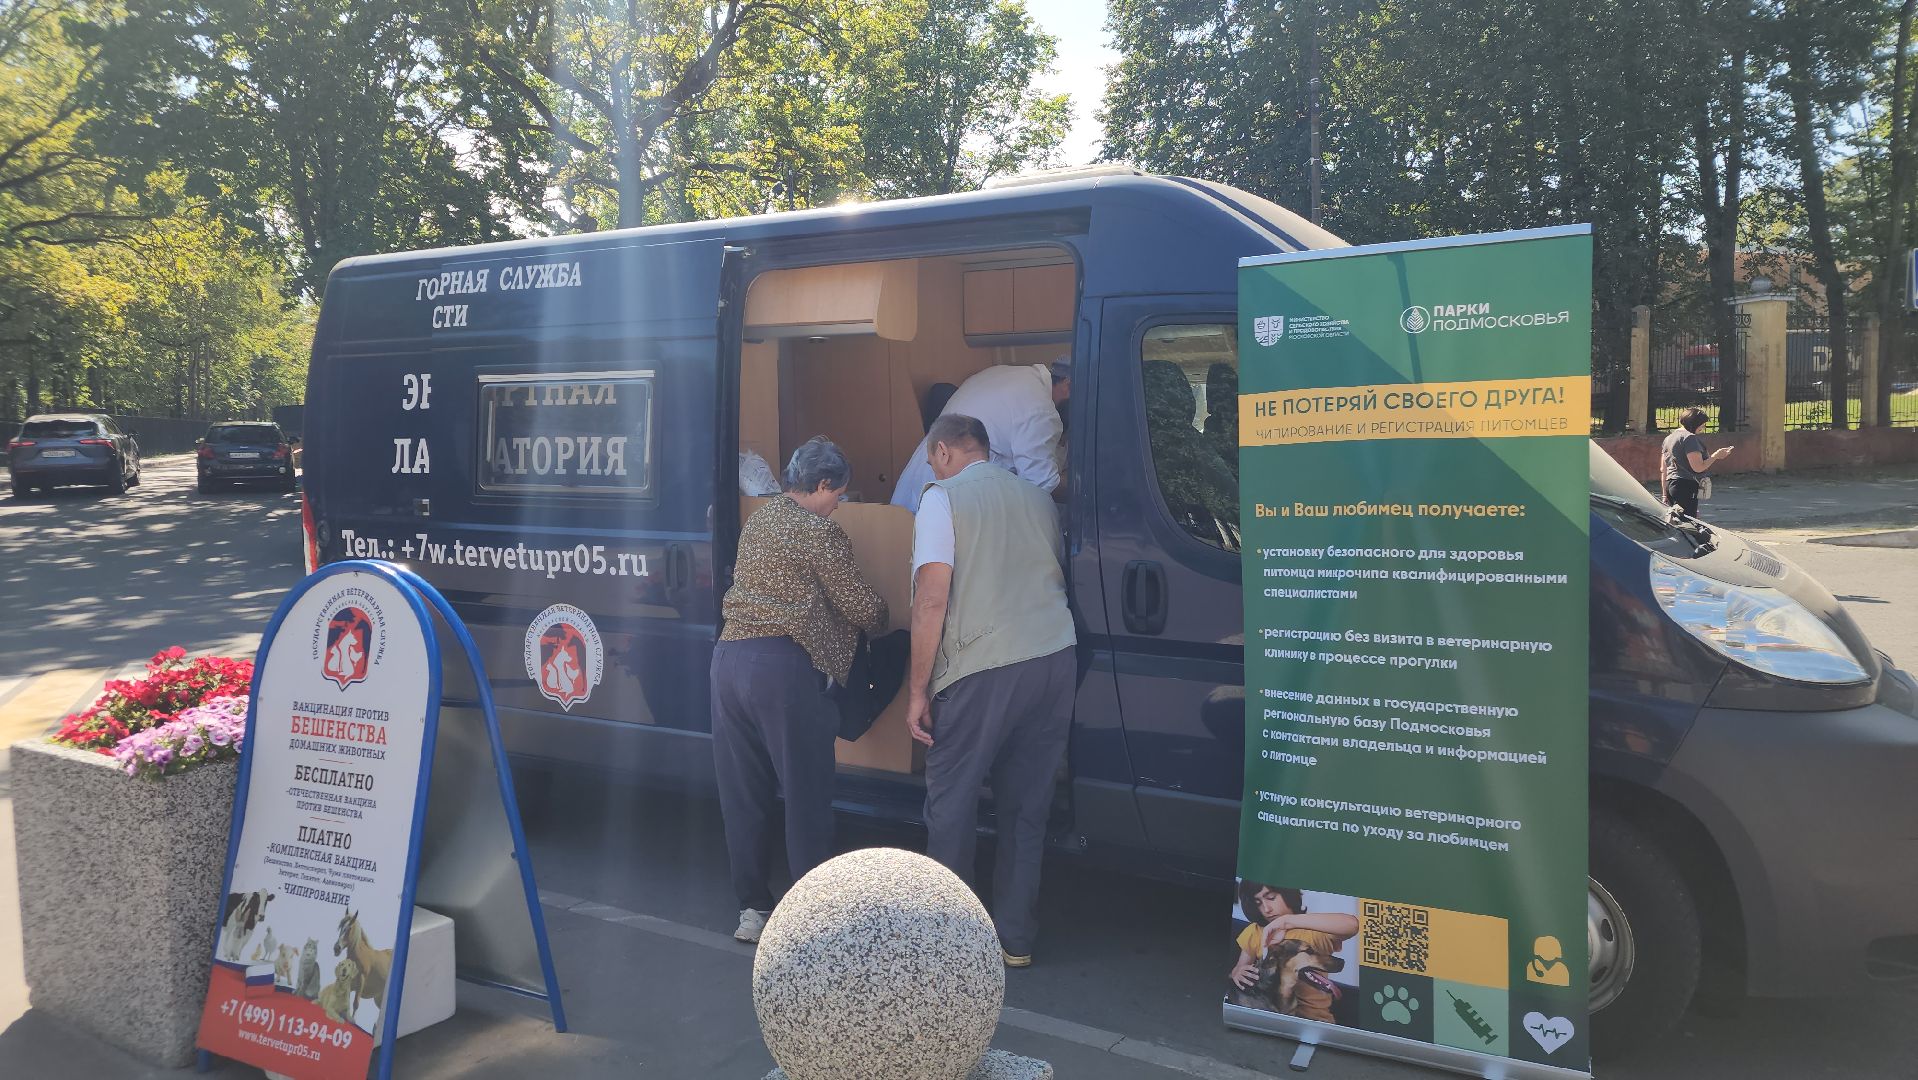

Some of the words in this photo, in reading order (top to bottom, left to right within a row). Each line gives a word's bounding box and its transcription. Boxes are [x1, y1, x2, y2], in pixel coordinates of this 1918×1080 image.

[416, 268, 490, 300] ГОРНАЯ
[500, 262, 582, 291] СЛУЖБА
[432, 304, 469, 329] СТИ
[1433, 302, 1490, 317] ПАРКИ
[1433, 311, 1570, 332] ПОДМОСКОВЬЯ
[1255, 400, 1277, 418] НЕ
[1282, 389, 1377, 416] ПОТЕРЯЙ
[1383, 390, 1478, 410] СВОЕГО
[1484, 386, 1565, 411] ДРУГА!
[1255, 422, 1352, 440] ЧИПИРОВАНИЕ
[1356, 422, 1367, 435] И
[1370, 420, 1476, 436] РЕГИСТРАЦИЯ
[1479, 416, 1568, 433] ПИТОМЦЕВ
[391, 438, 430, 474] ЛА
[1255, 503, 1277, 518] Вы
[1280, 506, 1291, 518] и
[1293, 502, 1329, 517] Ваш
[1332, 500, 1414, 518] любимец
[1417, 502, 1526, 520] получаете:
[341, 529, 395, 560] Тел.:
[1262, 546, 1325, 561] установку
[1327, 545, 1416, 559] безопасного
[1417, 547, 1447, 562] для
[1449, 549, 1524, 565] здоровья
[1263, 567, 1315, 580] питомца
[1317, 567, 1389, 581] микрочипа
[1392, 568, 1568, 585] квалифицированными
[1263, 586, 1358, 600] специалистами
[1264, 627, 1342, 643] регистрацию
[1344, 629, 1370, 643] без
[1373, 633, 1423, 646] визита
[1426, 636, 1434, 646] в
[1437, 636, 1553, 654] ветеринарную
[1264, 647, 1309, 662] клинику
[1309, 651, 1316, 660] в
[1318, 650, 1387, 666] процессе
[1389, 654, 1458, 670] прогулки
[292, 701, 353, 718] ВАКЦИНАЦИЯ
[355, 707, 390, 721] ПРОТИВ
[1264, 687, 1314, 702] внесение
[1316, 693, 1370, 707] данных
[1373, 697, 1381, 707] в
[1384, 698, 1519, 718] государственную
[290, 715, 388, 745] БЕШЕНСТВА
[1264, 708, 1350, 727] региональную
[1353, 715, 1387, 731] базу
[1390, 717, 1491, 738] Подмосковья
[288, 738, 338, 754] ДОМАШНИХ
[337, 745, 386, 761] ЖИВОТНЫХ
[1261, 749, 1268, 759] о
[1269, 749, 1317, 766] питомце
[1262, 729, 1269, 738] с
[1270, 729, 1339, 747] контактами
[1342, 737, 1422, 755] владельца
[1425, 744, 1434, 754] и
[1437, 745, 1548, 765] информацией
[294, 764, 374, 792] БЕСПЛАТНО
[296, 800, 322, 813] ПРОТИВ
[323, 805, 363, 820] БЕШЕНСТВА
[344, 795, 377, 809] ВАКЦИНА
[1300, 796, 1402, 817] консультацию
[1404, 808, 1522, 831] ветеринарного
[296, 825, 352, 850] ПЛАТНО
[1257, 810, 1339, 831] специалиста
[1342, 821, 1359, 833] по
[1362, 823, 1403, 841] уходу
[1406, 829, 1424, 842] за
[1426, 831, 1509, 852] любимцем
[334, 854, 377, 872] ВАКЦИНА
[284, 882, 351, 906] ЧИПИРОВАНИЕ
[220, 998, 239, 1017] +7
[238, 1000, 276, 1032] (499)
[278, 1013, 353, 1049] 113-94-09
[237, 1028, 321, 1061] www.tervetupr05.ru
